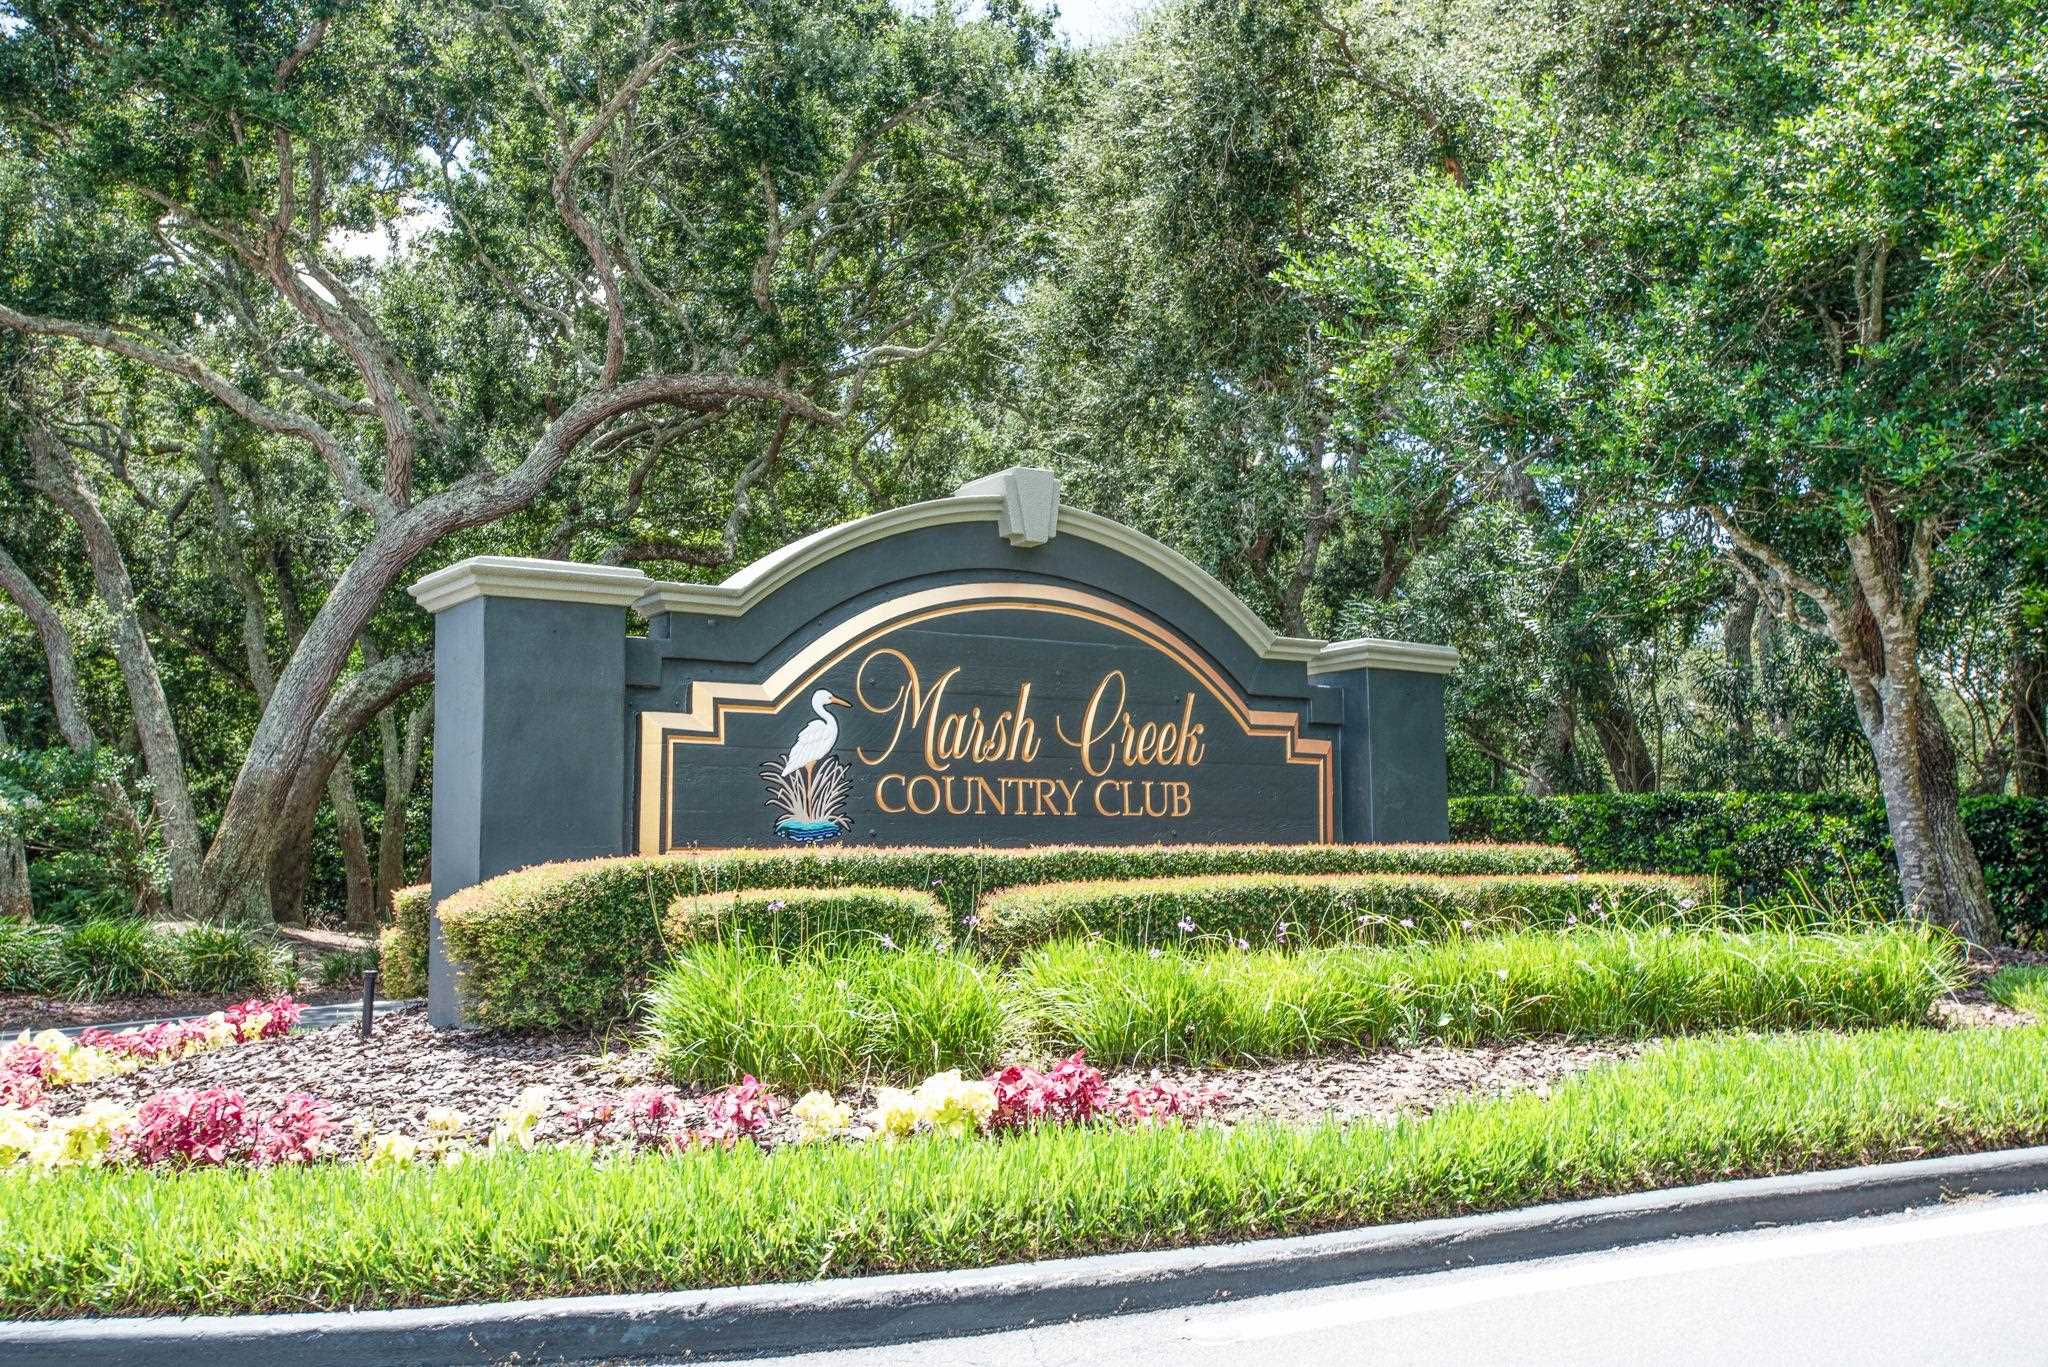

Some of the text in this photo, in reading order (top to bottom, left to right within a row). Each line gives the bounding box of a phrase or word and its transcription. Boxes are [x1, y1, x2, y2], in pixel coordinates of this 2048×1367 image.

[856, 648, 1206, 777] Marsh Creek
[875, 774, 1192, 817] COUNTRY CLUB
